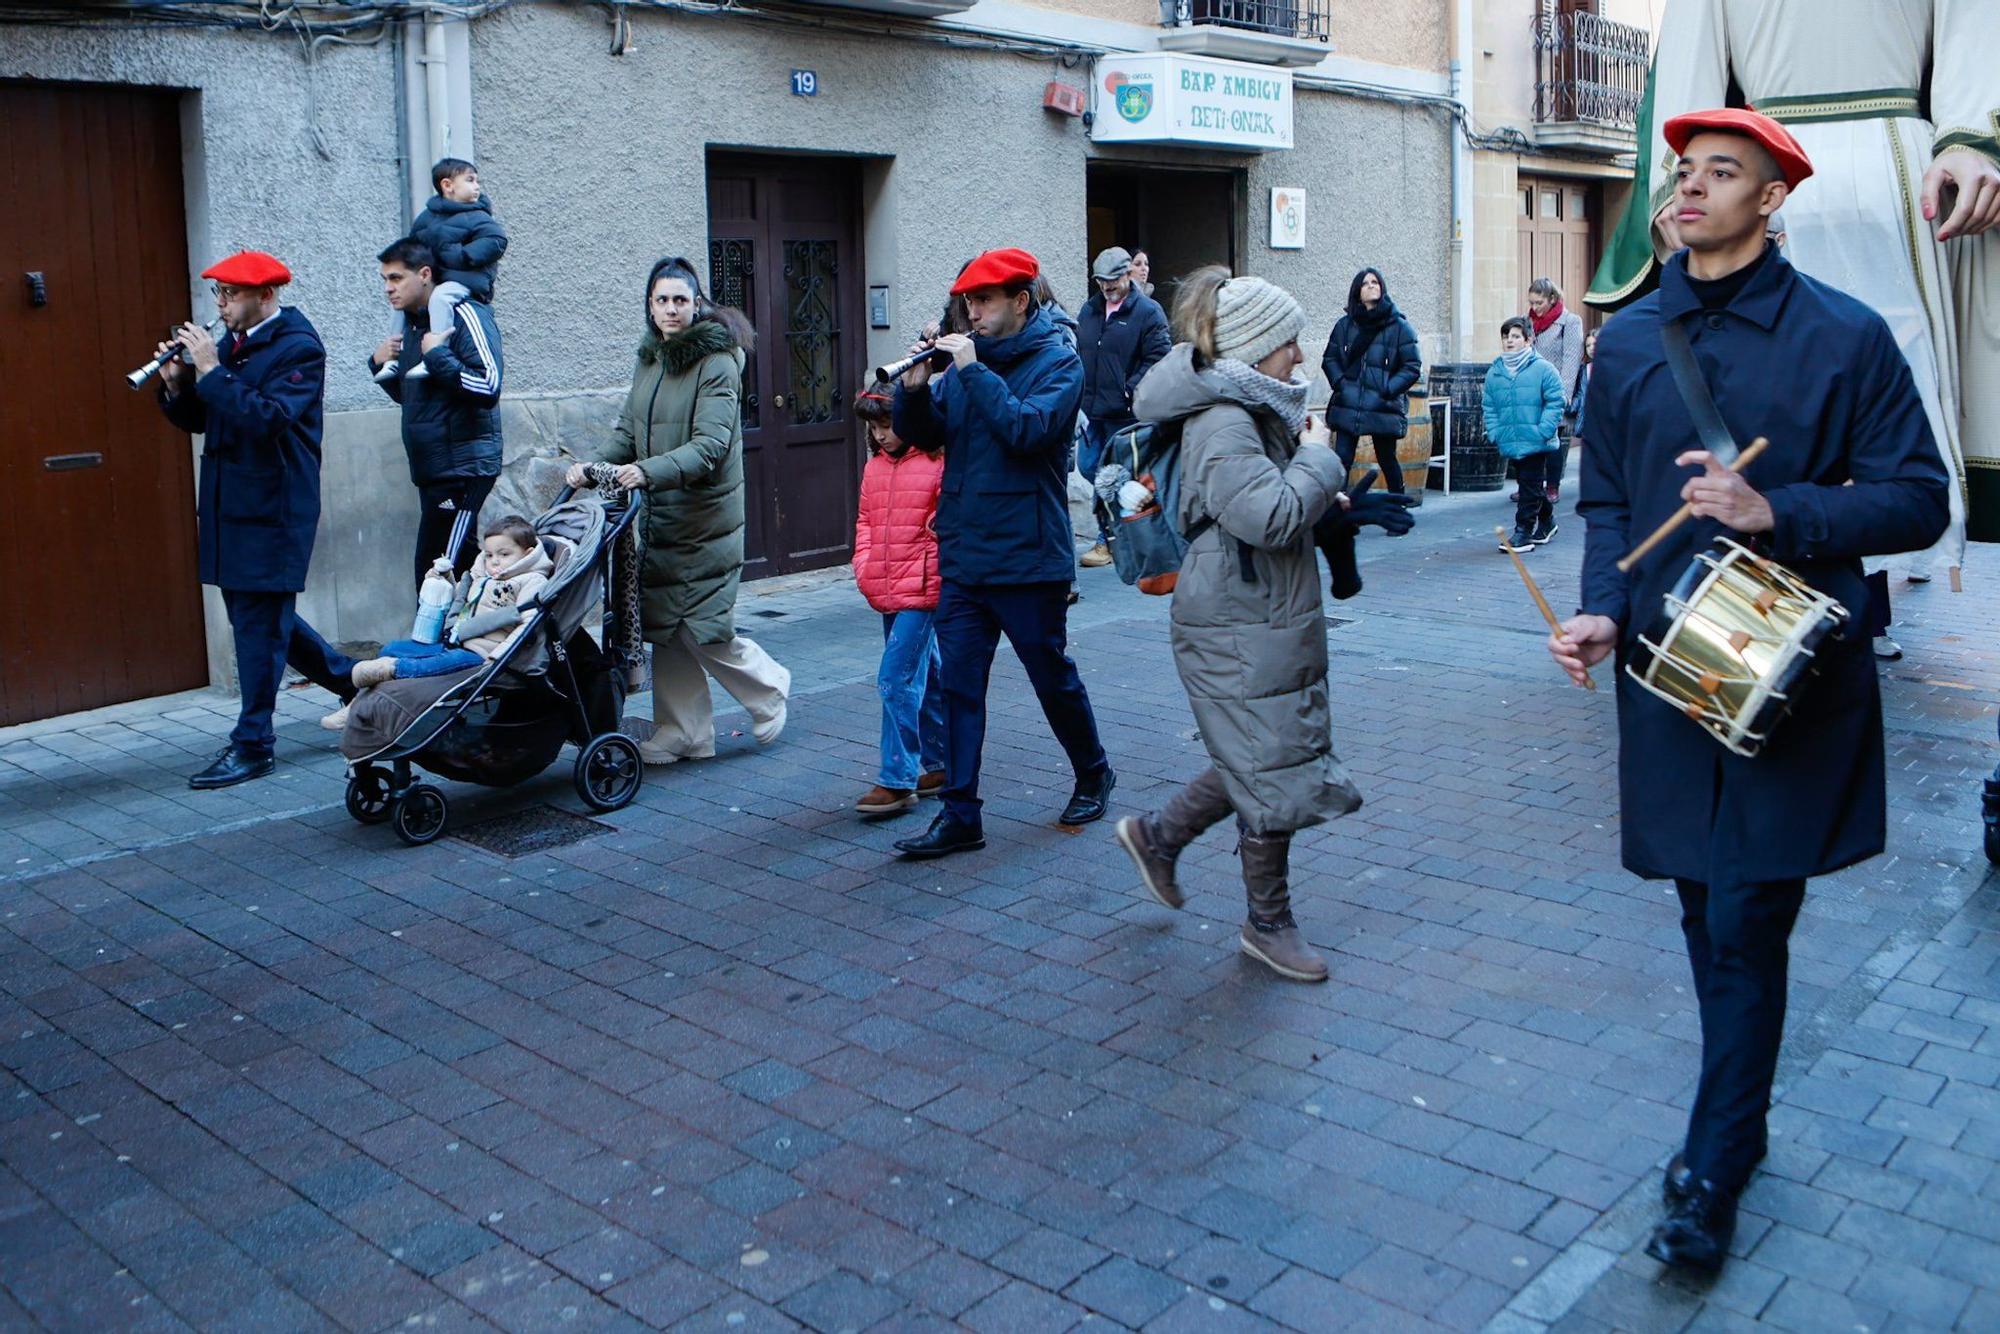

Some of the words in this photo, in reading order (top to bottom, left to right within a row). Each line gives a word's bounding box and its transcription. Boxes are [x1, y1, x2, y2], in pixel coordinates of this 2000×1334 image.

[794, 71, 815, 92] 19
[1181, 69, 1215, 92] BAR
[552, 640, 566, 661] Joie
